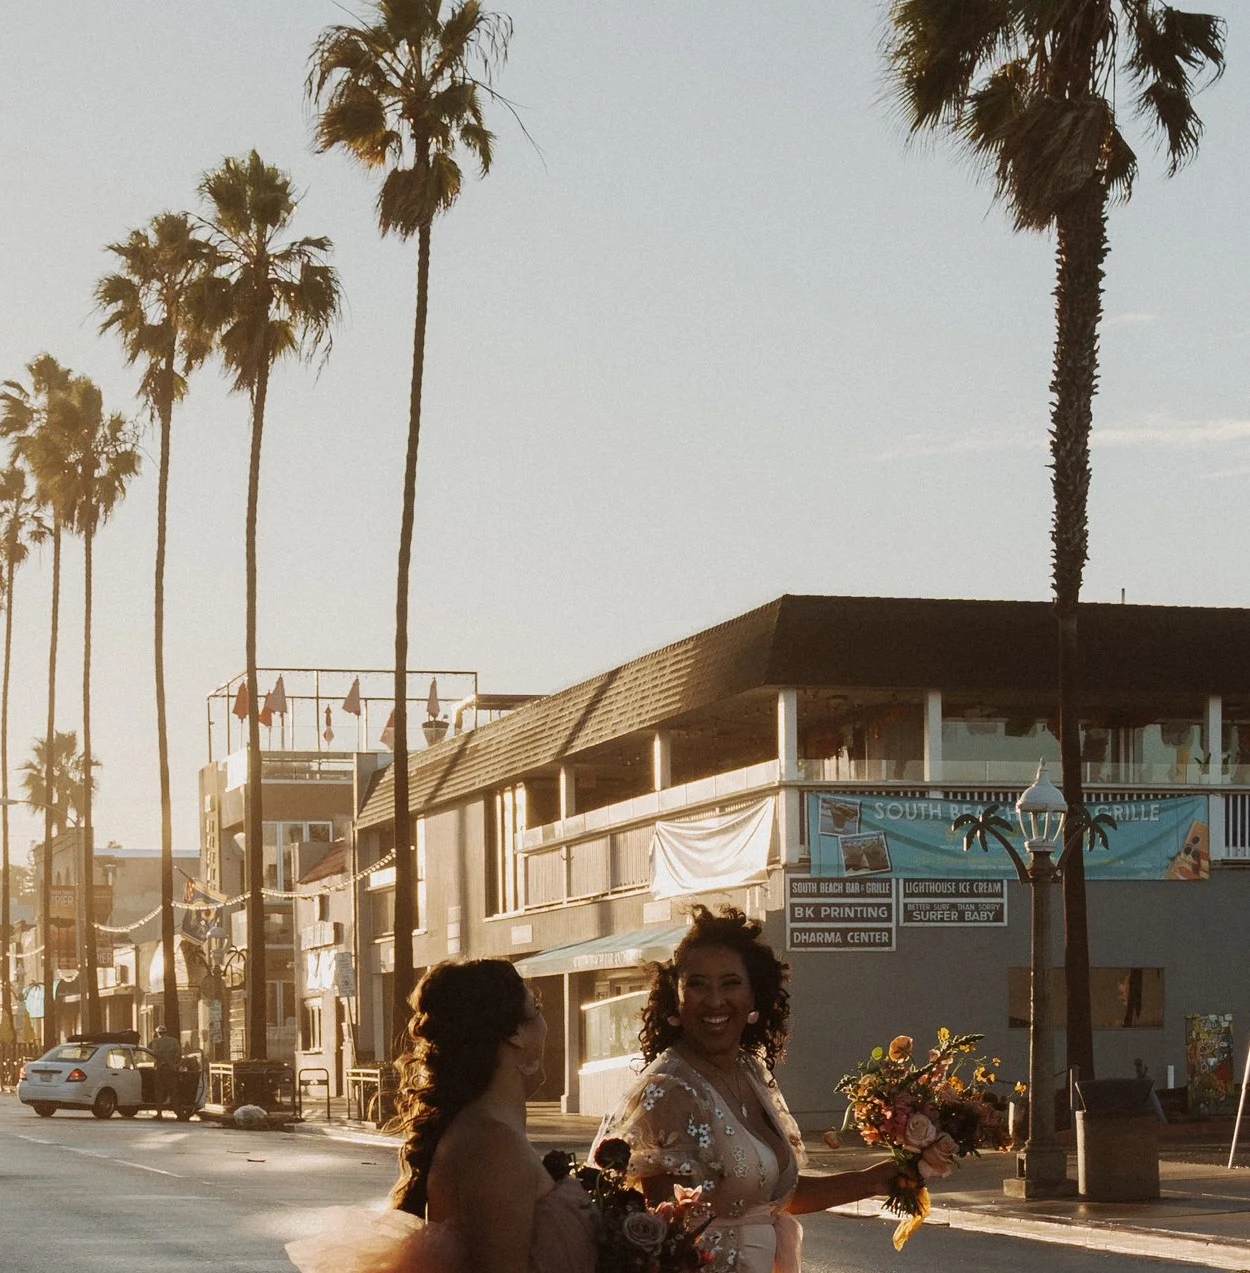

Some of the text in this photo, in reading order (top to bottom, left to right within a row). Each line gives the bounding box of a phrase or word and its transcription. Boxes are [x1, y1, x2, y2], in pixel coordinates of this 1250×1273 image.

[875, 802, 942, 820] SOUTH
[950, 803, 1020, 821] BEAH
[1095, 804, 1160, 821] GRILLE
[792, 882, 817, 893] SOUTH
[819, 882, 843, 893] BEACH
[845, 882, 860, 893] BAR
[866, 882, 890, 893] GRILLE
[905, 882, 1002, 893] LIGHTHOUSE ICE CREAM
[794, 906, 888, 918] BK PRINTING
[907, 903, 931, 911] BETTER
[957, 903, 975, 911] THAN
[978, 903, 1001, 911] SORRY
[912, 911, 995, 921] SURFER BABY
[793, 931, 889, 943] DHARMA CENTER
